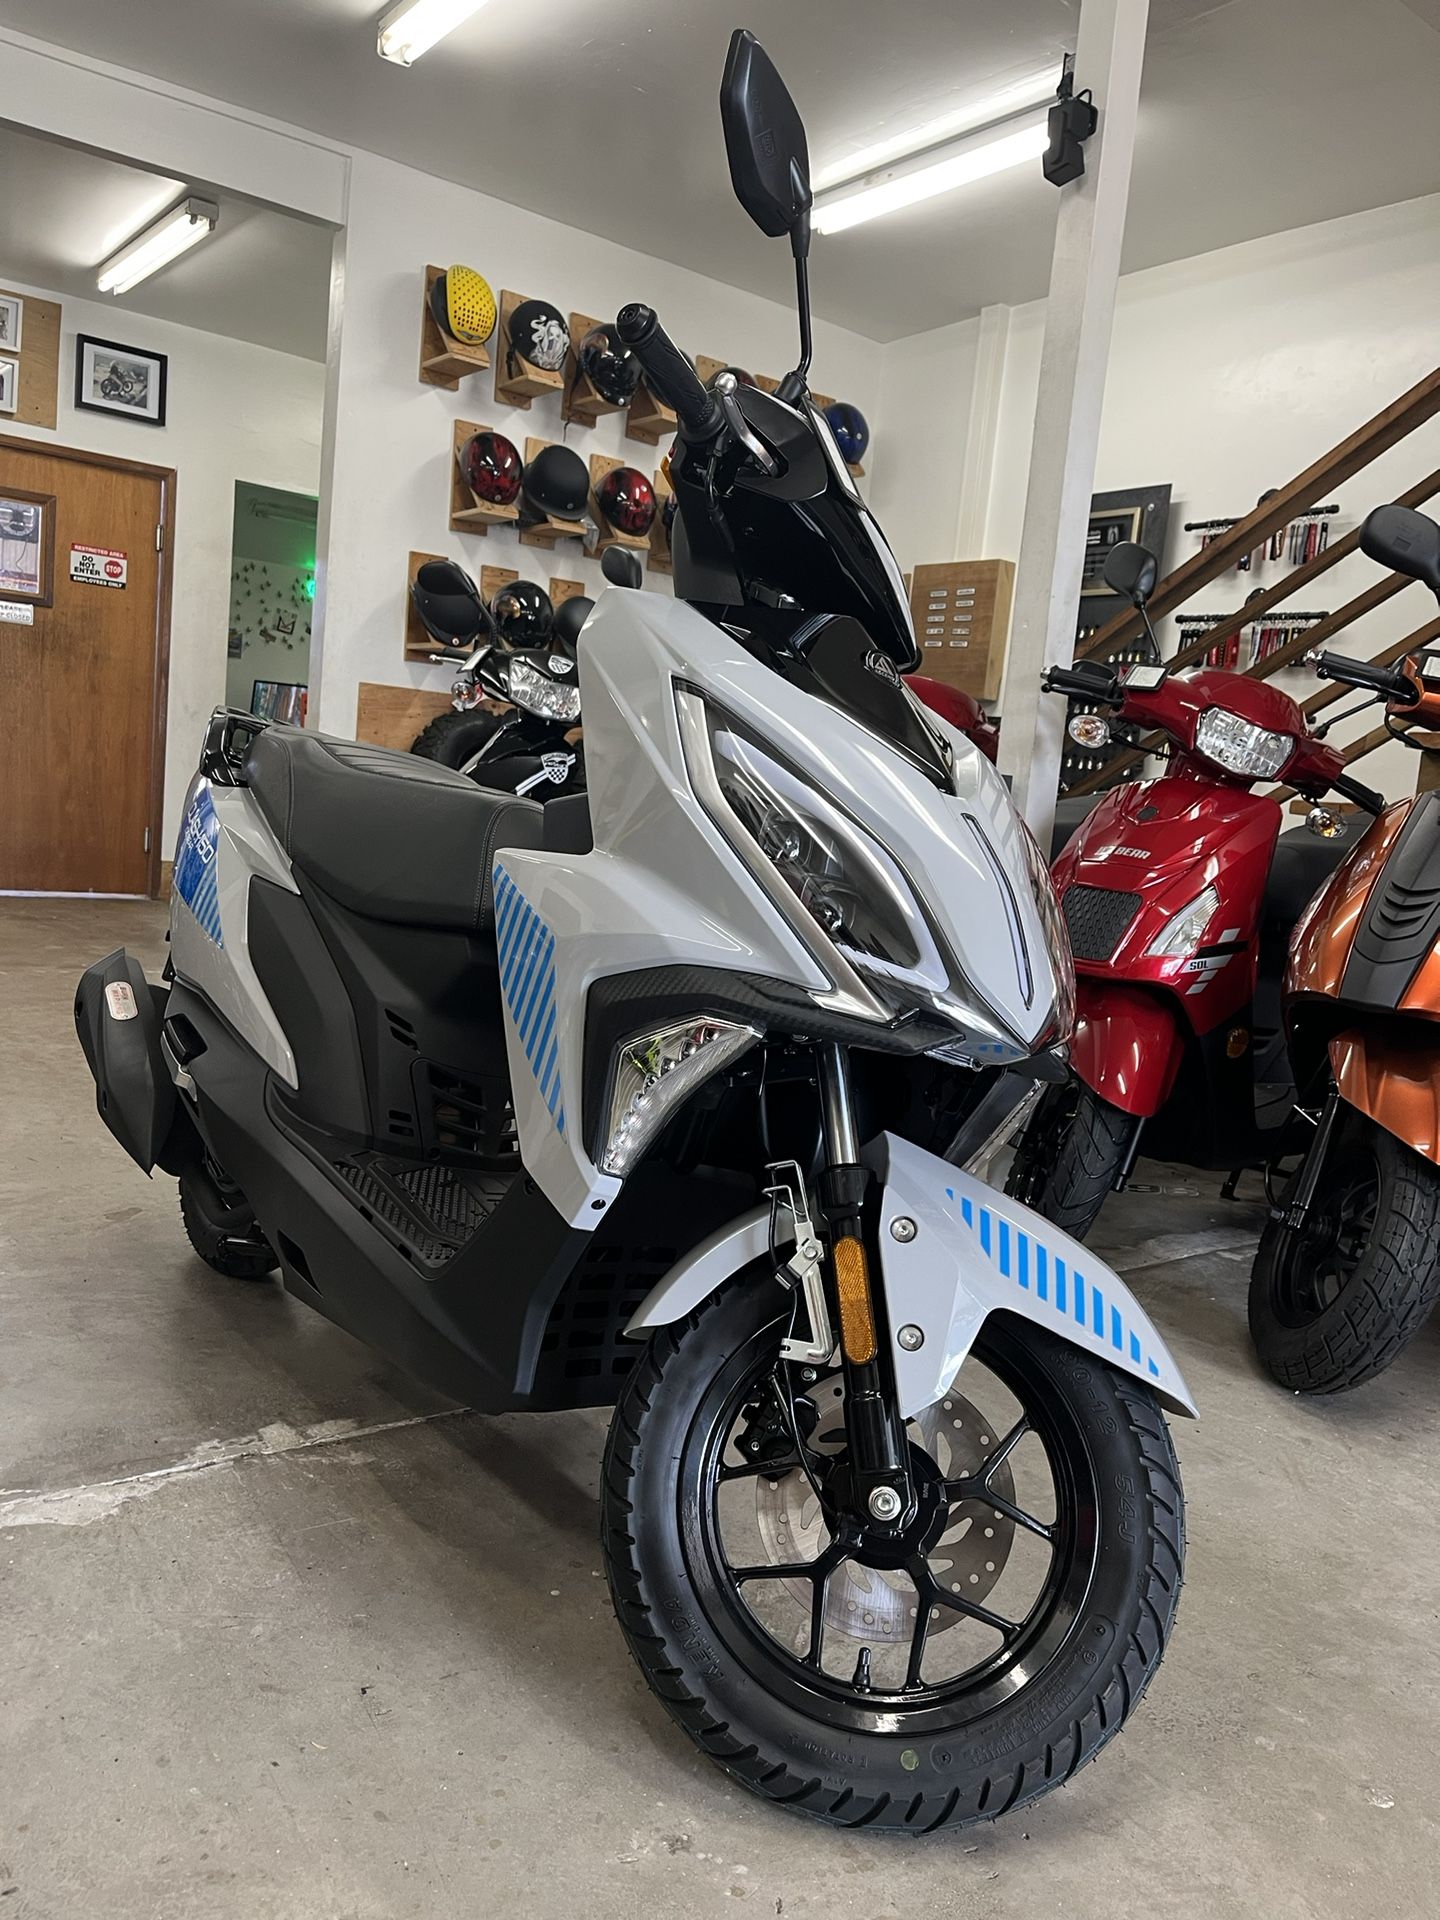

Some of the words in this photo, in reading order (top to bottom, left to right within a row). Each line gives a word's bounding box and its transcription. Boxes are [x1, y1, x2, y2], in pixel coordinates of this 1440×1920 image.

[74, 544, 109, 555] RESTRICTED
[109, 550, 124, 558] AREA
[79, 561, 96, 569] NOT
[106, 564, 122, 575] STOP
[74, 566, 101, 576] ENTER
[73, 576, 107, 586] EMPLOYEES
[1189, 960, 1209, 970] SOL
[1114, 1473, 1136, 1545] 54J
[662, 1596, 726, 1683] KENDA
